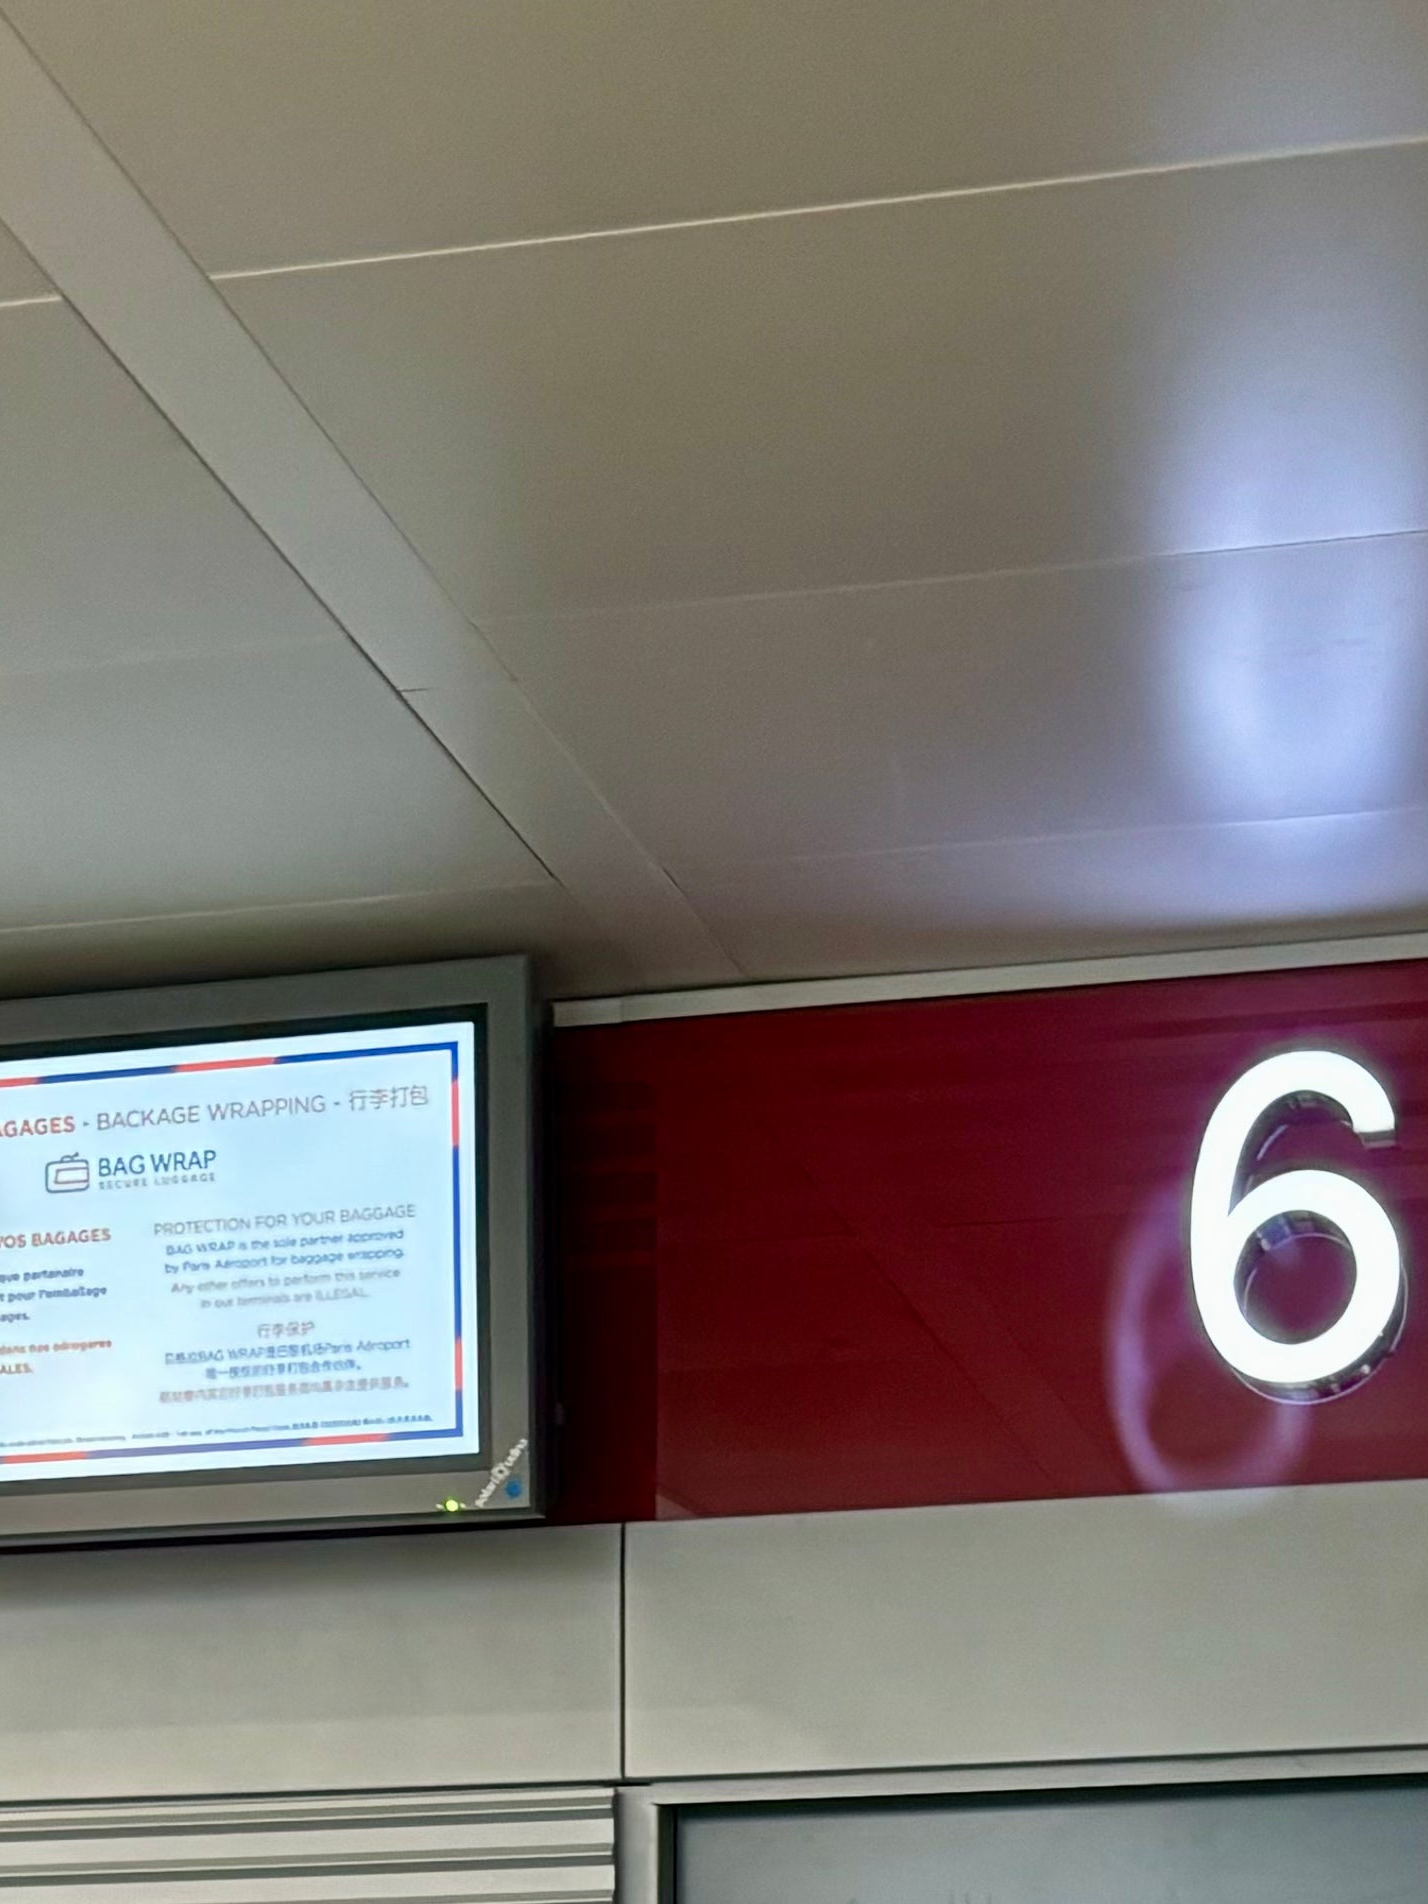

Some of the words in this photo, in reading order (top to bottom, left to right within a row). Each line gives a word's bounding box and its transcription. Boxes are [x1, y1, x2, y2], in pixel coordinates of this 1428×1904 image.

[97, 1105, 200, 1131] BACKAGE
[208, 1094, 326, 1122] WRAPPING
[349, 1085, 429, 1111] 行李打包
[98, 1154, 145, 1177] BAG
[150, 1150, 217, 1173] WRAP
[154, 1217, 251, 1236] PROTECTION
[255, 1213, 287, 1229] FOR
[291, 1209, 335, 1227] YOUR
[340, 1204, 416, 1222] BAGGAGE
[1190, 1050, 1403, 1390] 6
[31, 1227, 111, 1247] BAGAGES
[166, 1244, 192, 1256] BAG
[196, 1240, 236, 1253] WRAP
